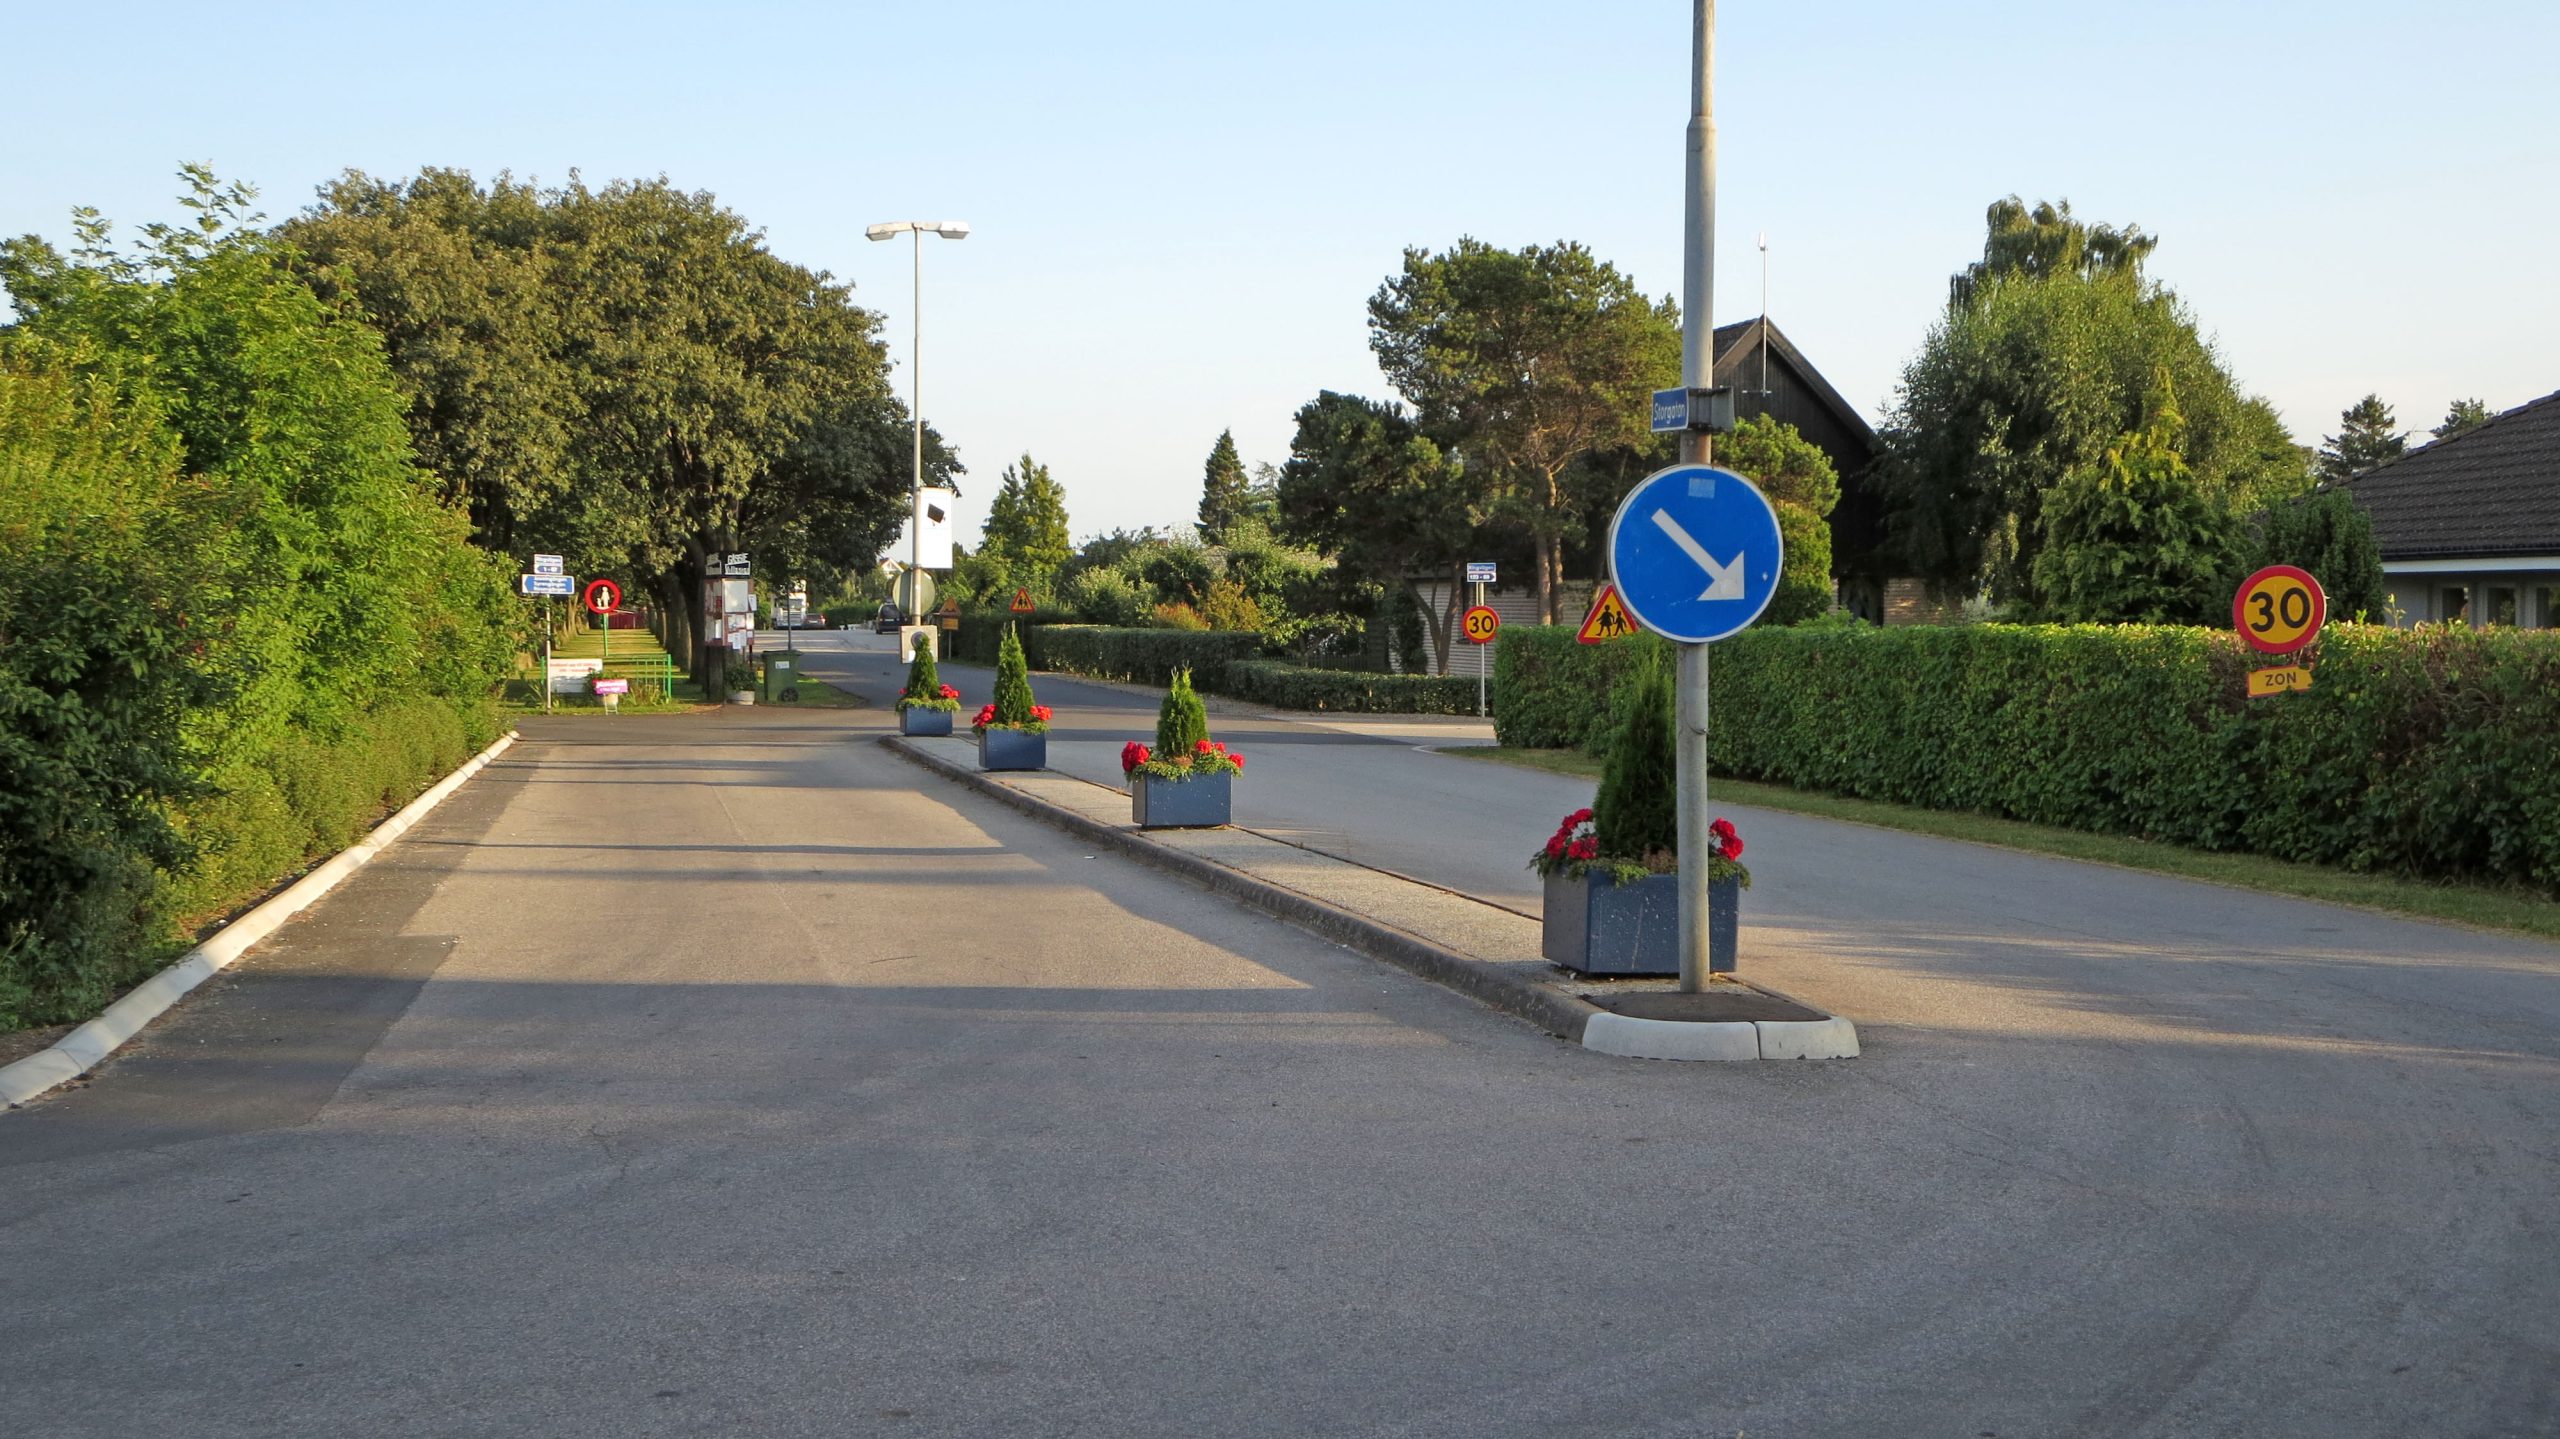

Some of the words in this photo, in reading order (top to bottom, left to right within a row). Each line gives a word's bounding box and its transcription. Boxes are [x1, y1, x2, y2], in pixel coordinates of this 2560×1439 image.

[1654, 401, 1686, 425] Storgatan
[2250, 587, 2311, 632] 30
[1469, 616, 1494, 633] 30
[2265, 672, 2297, 687] ZON
